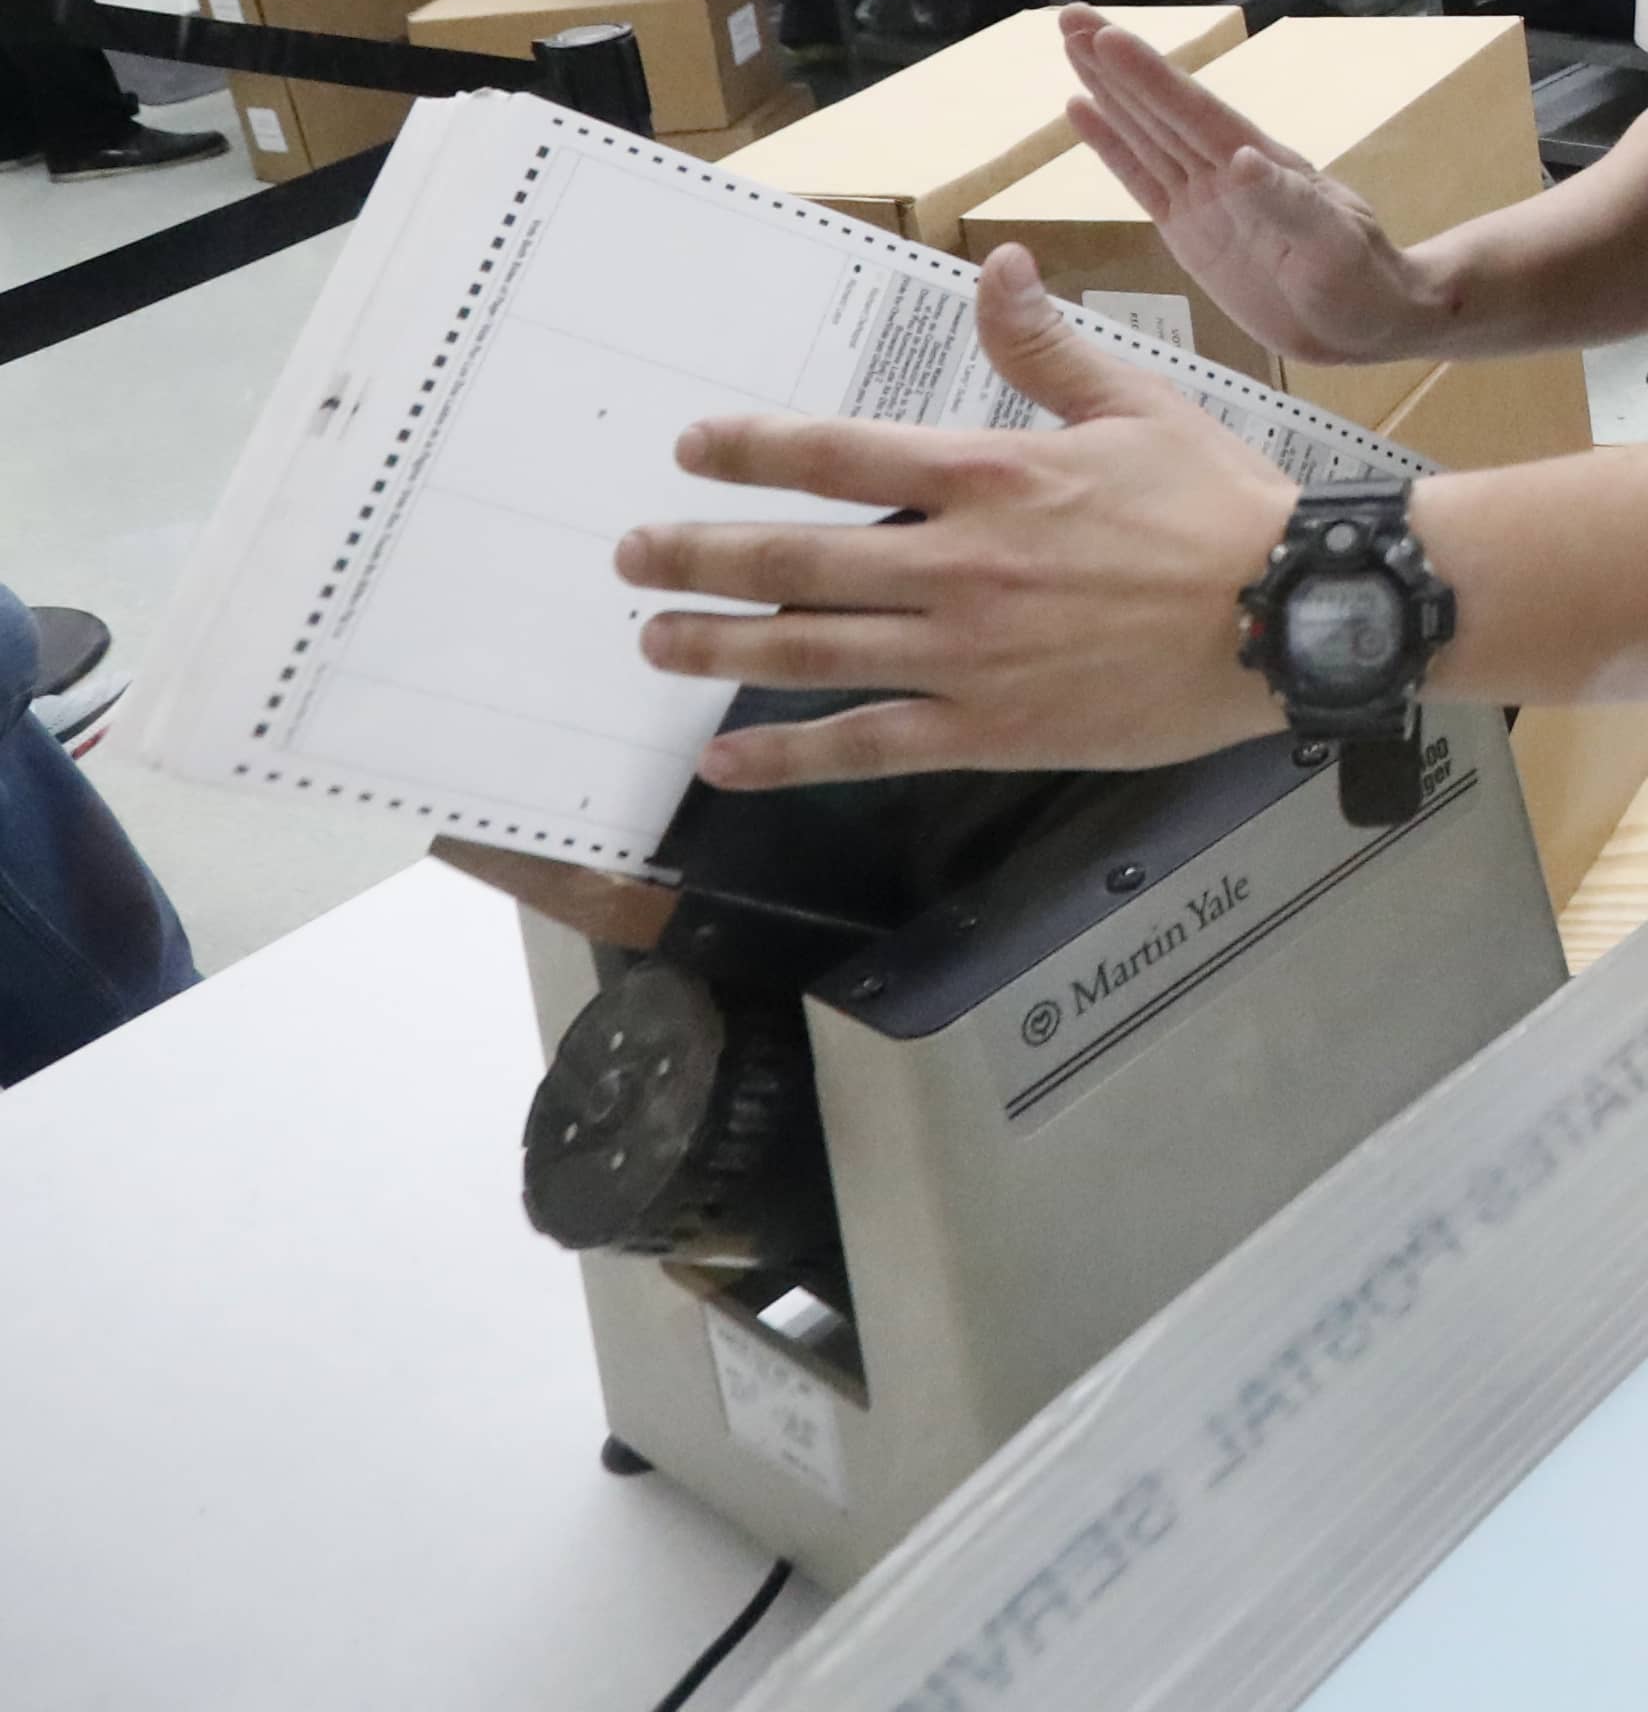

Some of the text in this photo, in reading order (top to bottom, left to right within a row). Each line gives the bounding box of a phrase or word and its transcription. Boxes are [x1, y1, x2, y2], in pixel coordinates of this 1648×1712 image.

[1424, 758, 1450, 797] ger
[1072, 876, 1249, 1016] Martin Yale
